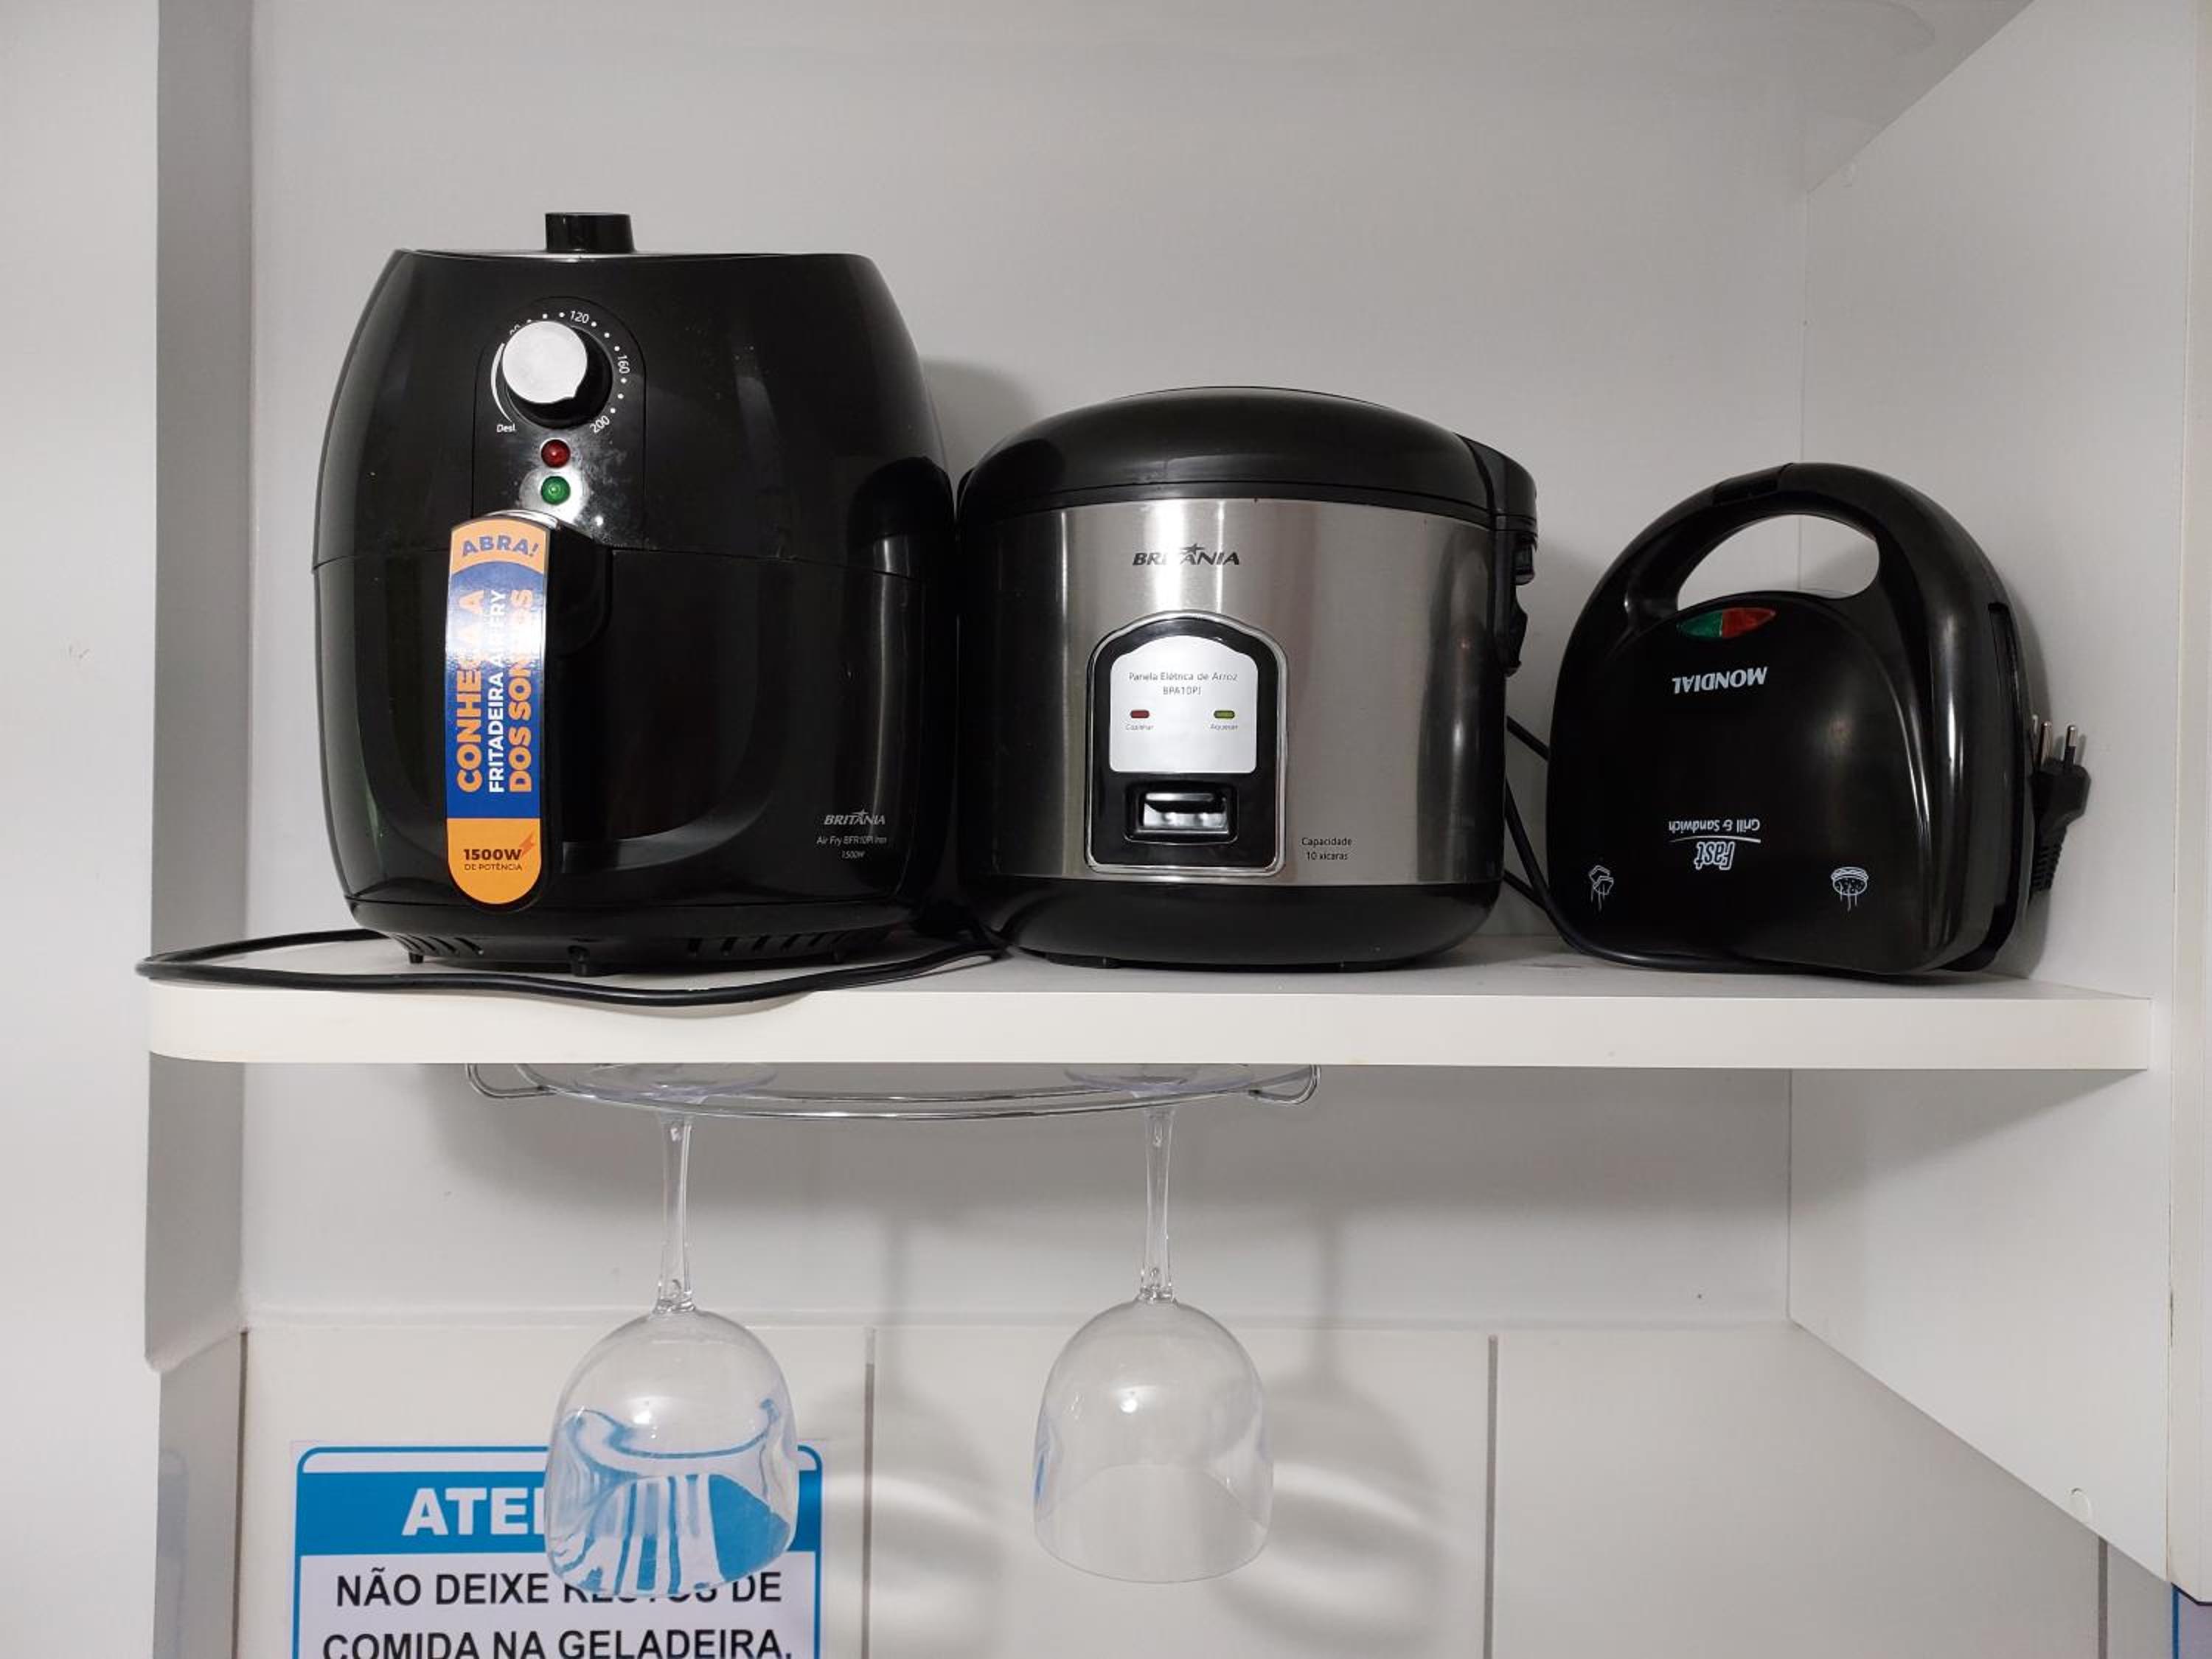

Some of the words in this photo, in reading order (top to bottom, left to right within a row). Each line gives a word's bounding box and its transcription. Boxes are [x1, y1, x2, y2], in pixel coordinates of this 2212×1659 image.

[570, 310, 589, 323] 120
[617, 355, 630, 374] 160
[590, 415, 610, 434] 200
[462, 535, 539, 557] ABRA!
[1129, 672, 1158, 681] Panela
[1197, 672, 1209, 681] de
[1211, 672, 1238, 681] Arroz
[1672, 667, 1767, 694] MONDIAL
[487, 672, 504, 793] FRITADEIRA
[508, 726, 532, 793] DOS
[1669, 819, 1720, 833] Sandwich
[1736, 818, 1761, 832] Grill
[1301, 837, 1352, 848] Capacidade
[463, 849, 522, 860] 1500W
[1307, 852, 1317, 860] 10
[1694, 841, 1735, 870] Fast
[479, 862, 523, 872] POTÊNCIA
[337, 1567, 421, 1606] NÃO
[436, 1573, 549, 1604] DEIXE
[732, 1572, 782, 1603] DE
[323, 1632, 480, 1659] COMIDA
[493, 1630, 546, 1659] NA
